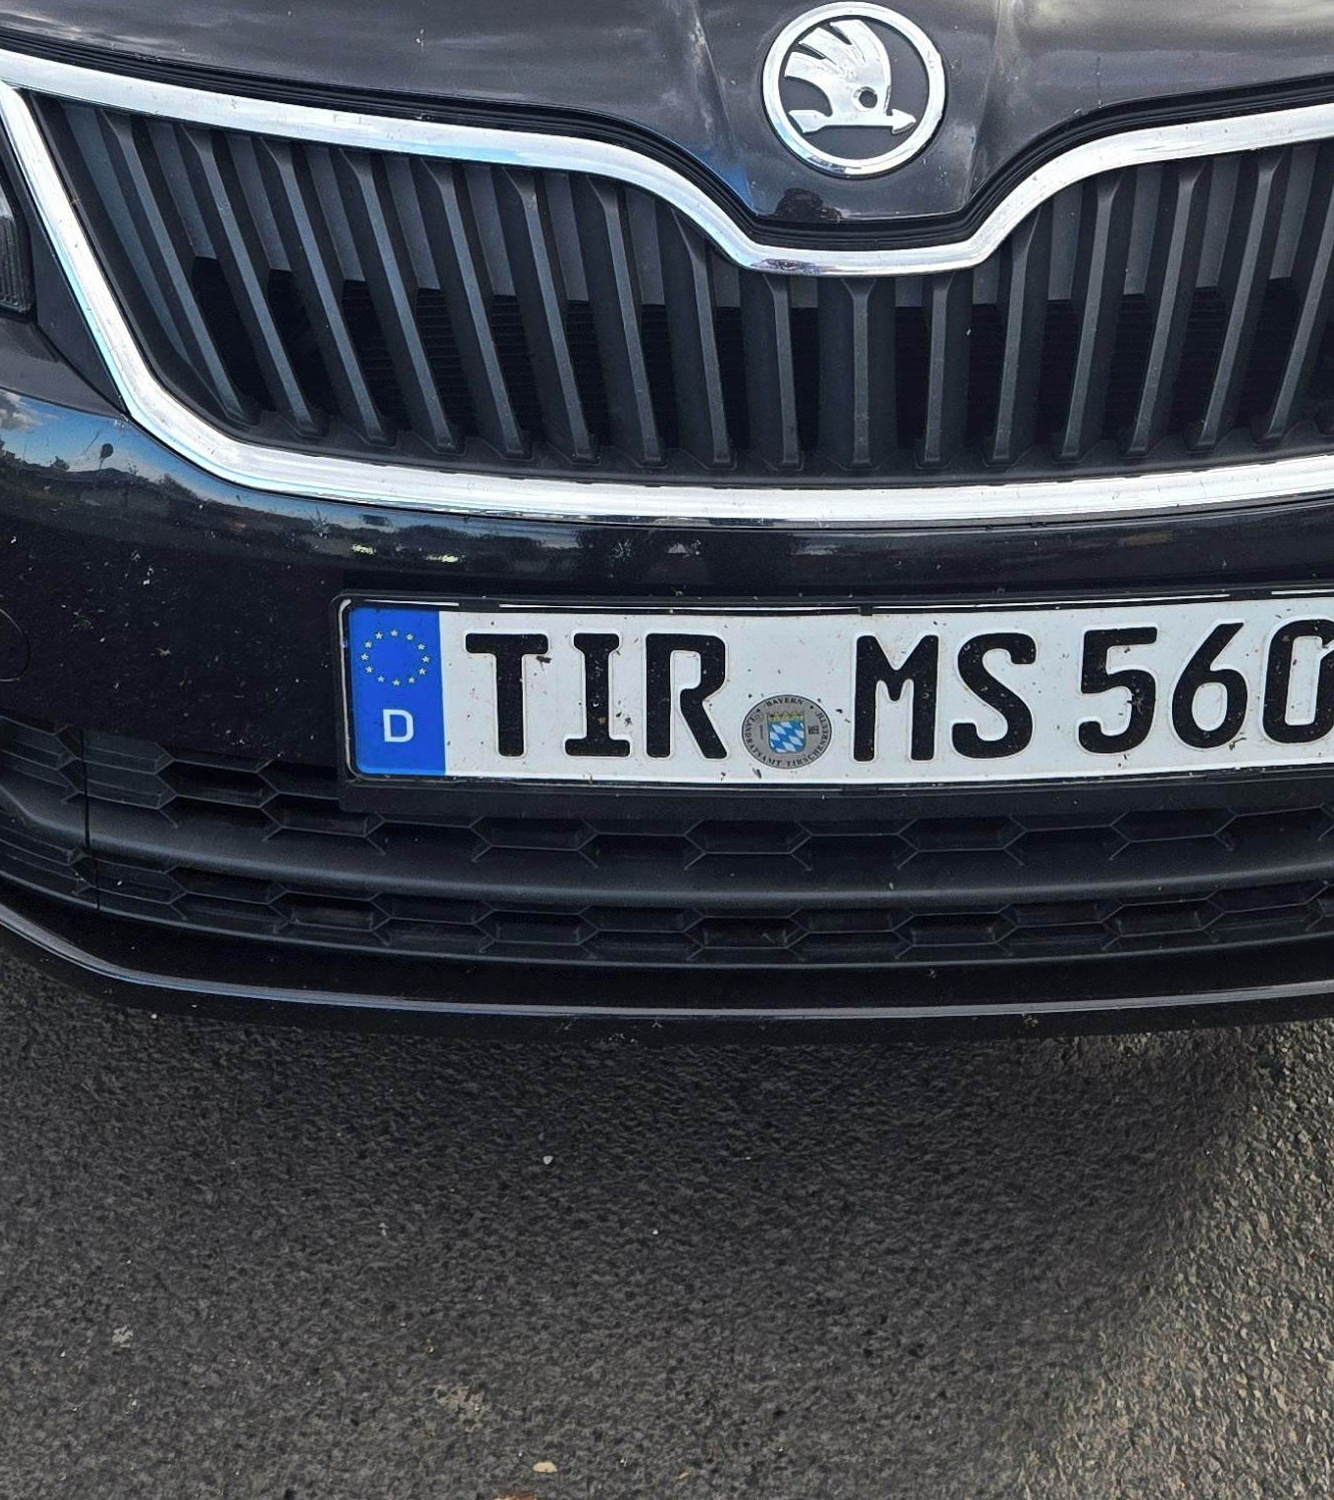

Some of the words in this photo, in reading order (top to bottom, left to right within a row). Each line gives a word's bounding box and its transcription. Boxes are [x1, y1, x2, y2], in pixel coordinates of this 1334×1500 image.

[465, 633, 728, 759] TIR
[853, 632, 1036, 762] MS
[765, 697, 804, 707] BAYERN
[382, 709, 414, 743] D
